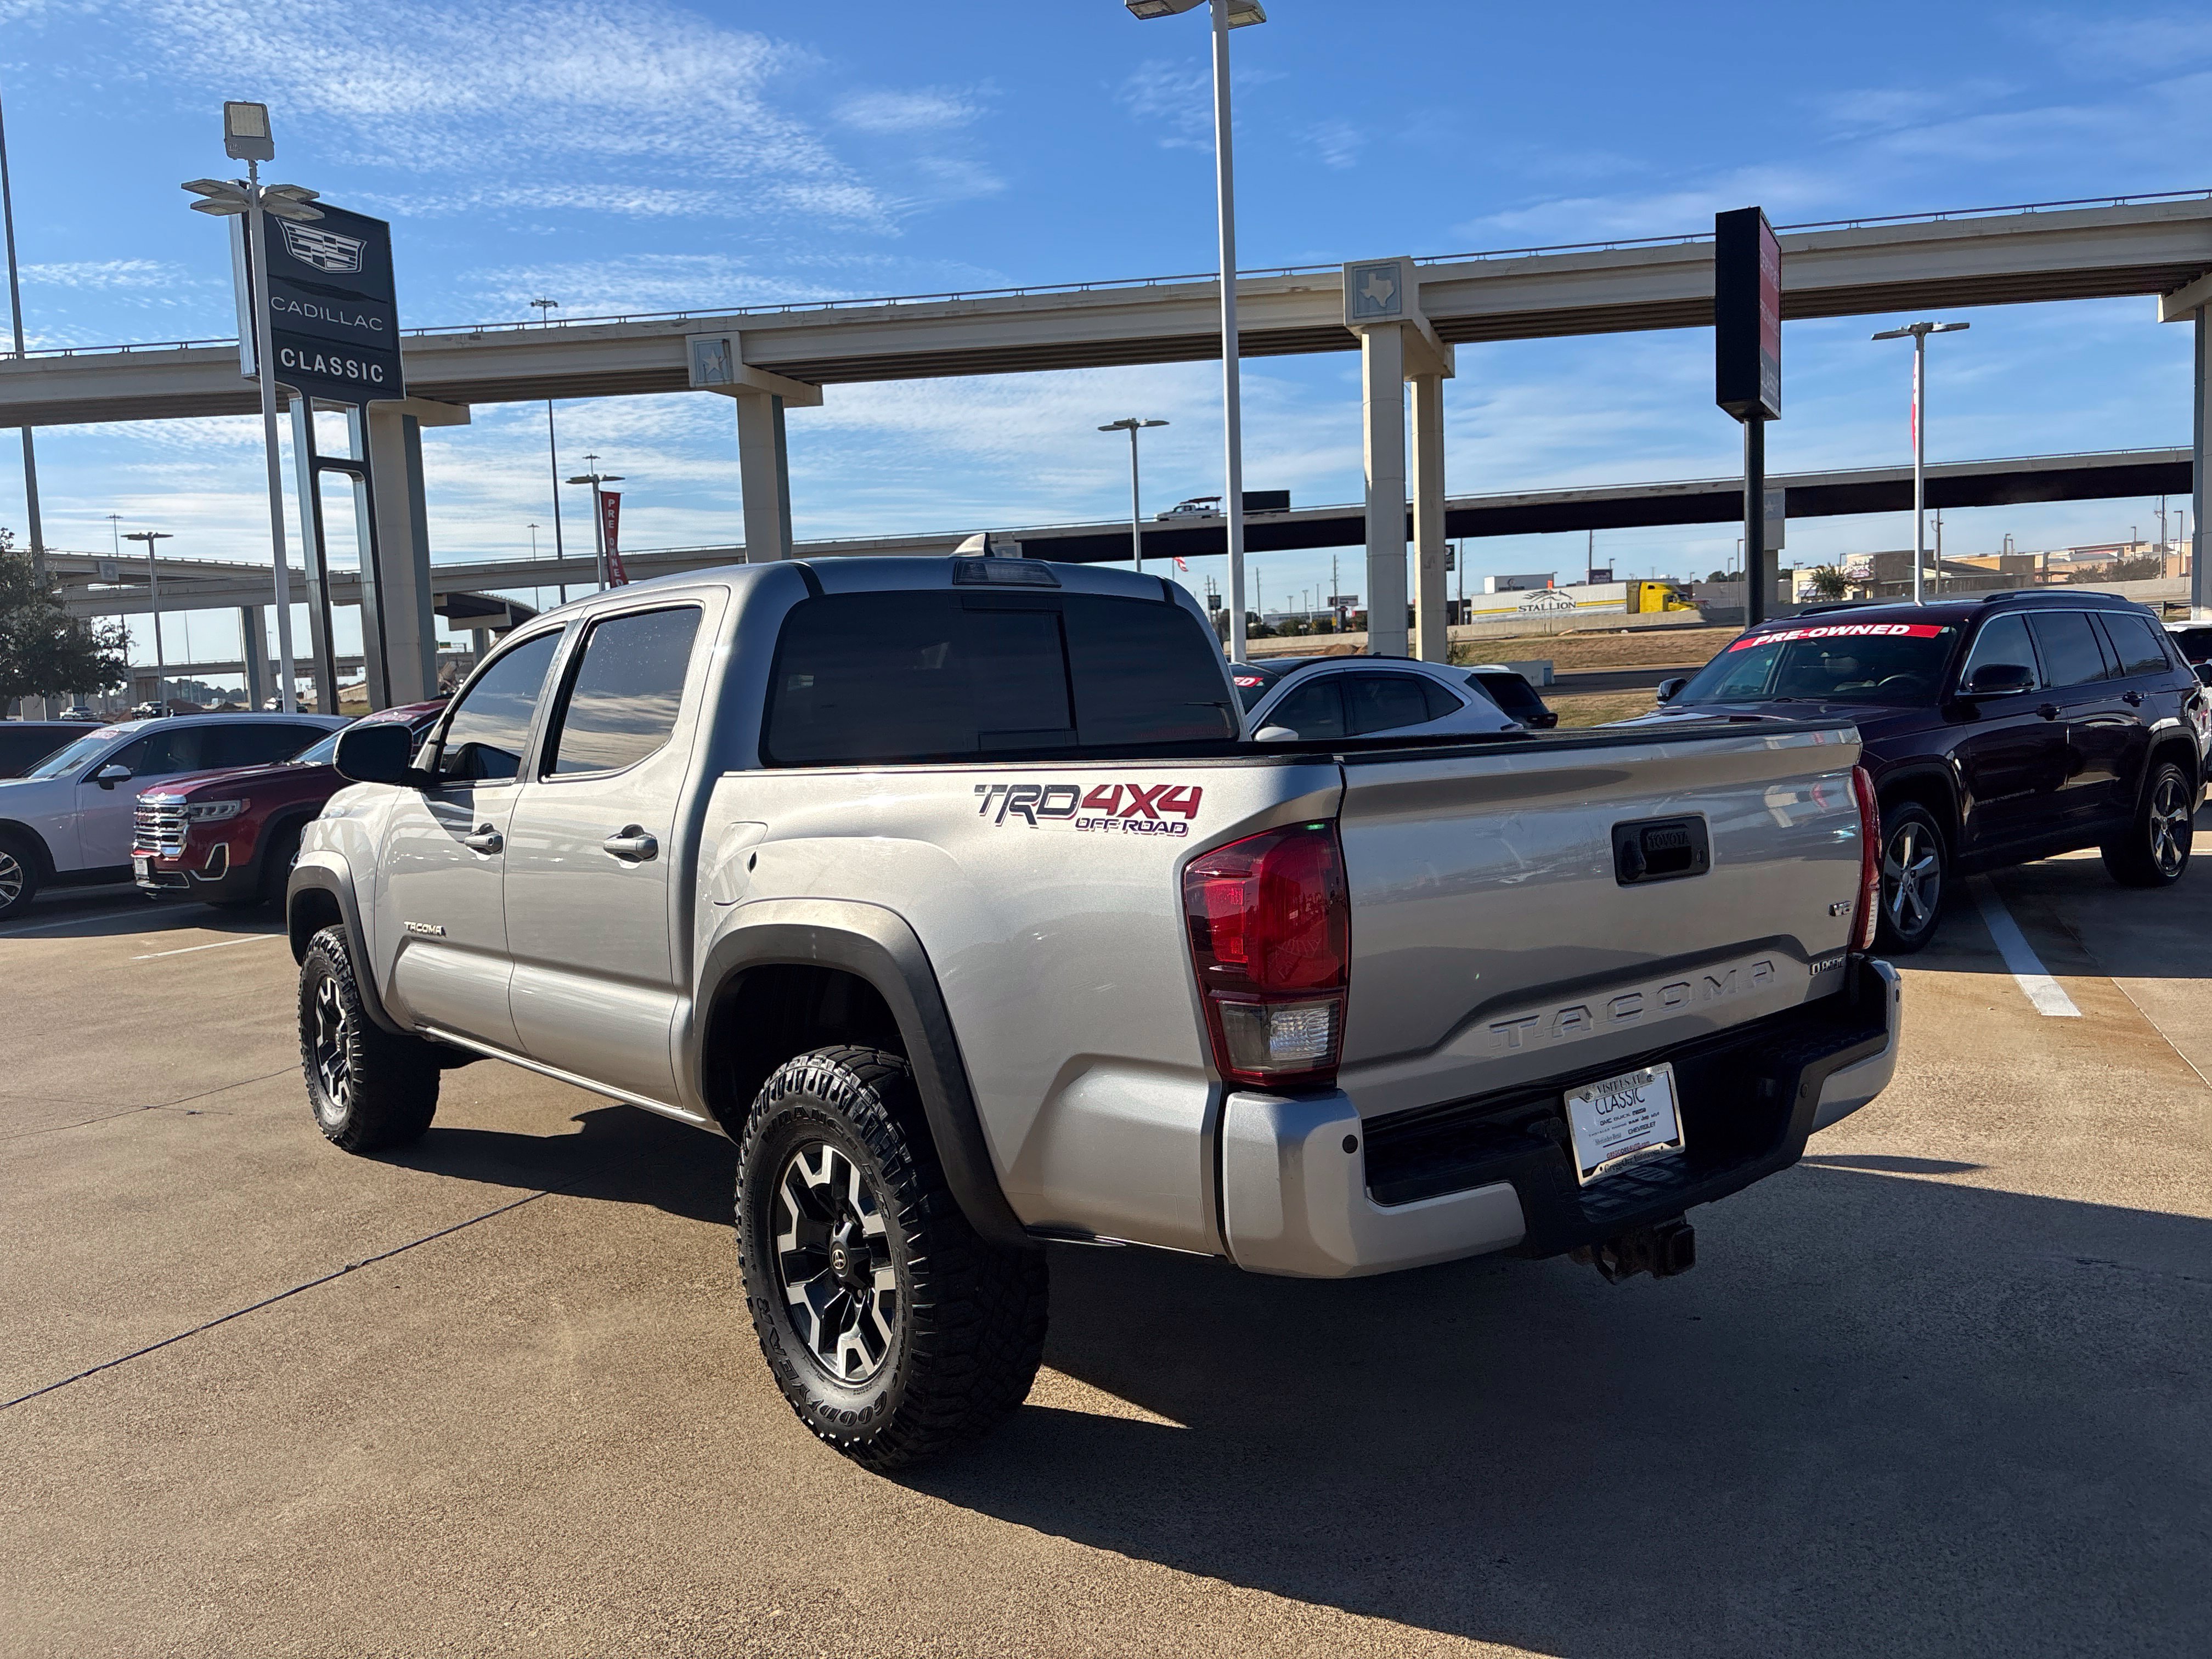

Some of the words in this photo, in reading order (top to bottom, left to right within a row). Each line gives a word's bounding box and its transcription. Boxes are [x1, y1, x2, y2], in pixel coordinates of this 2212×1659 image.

[271, 296, 383, 331] CADILLAC
[280, 348, 383, 382] CLASSIC
[607, 498, 616, 529] PRE
[609, 537, 624, 587] OWNED
[1518, 601, 1577, 612] STALLION
[1751, 624, 1910, 647] PRE-OWNED
[974, 784, 1082, 829] TRD
[1075, 817, 1120, 833] OFF
[1121, 820, 1189, 837] ROAD
[1646, 831, 1690, 849] TOYOTA
[404, 921, 445, 936] TACOMA
[1488, 960, 1775, 1049] TACOMA
[1597, 1080, 1617, 1093] VISIT
[1595, 1088, 1645, 1115] CLASSIC
[757, 1295, 888, 1426] GOODYEAR
